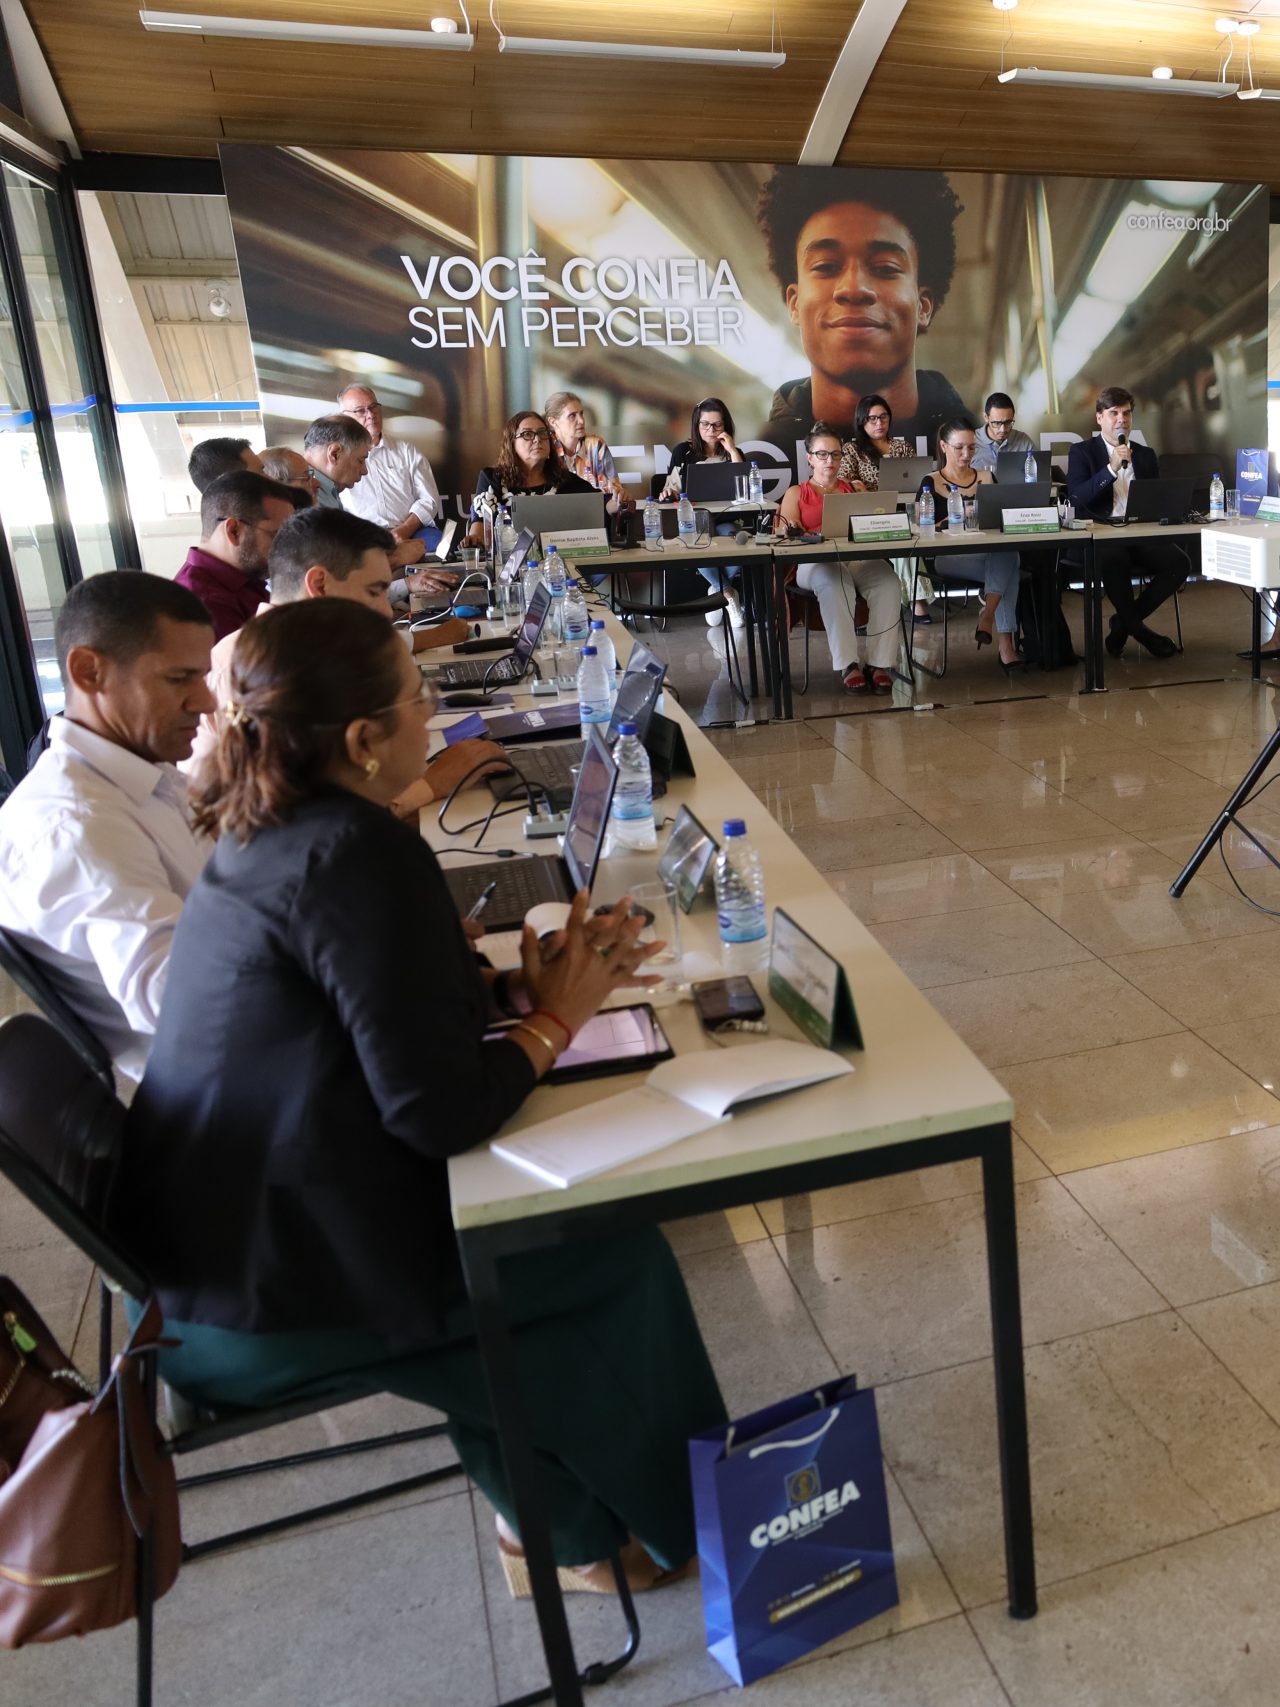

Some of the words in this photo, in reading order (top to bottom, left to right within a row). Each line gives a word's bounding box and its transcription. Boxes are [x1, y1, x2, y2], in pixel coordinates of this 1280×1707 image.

[1127, 210, 1232, 237] confea.org.br
[400, 249, 549, 301] VOCÊ
[562, 256, 743, 301] CONFIA
[409, 306, 507, 349] SEM
[522, 306, 746, 348] PERCEBER
[749, 1480, 861, 1548] CONFEA
